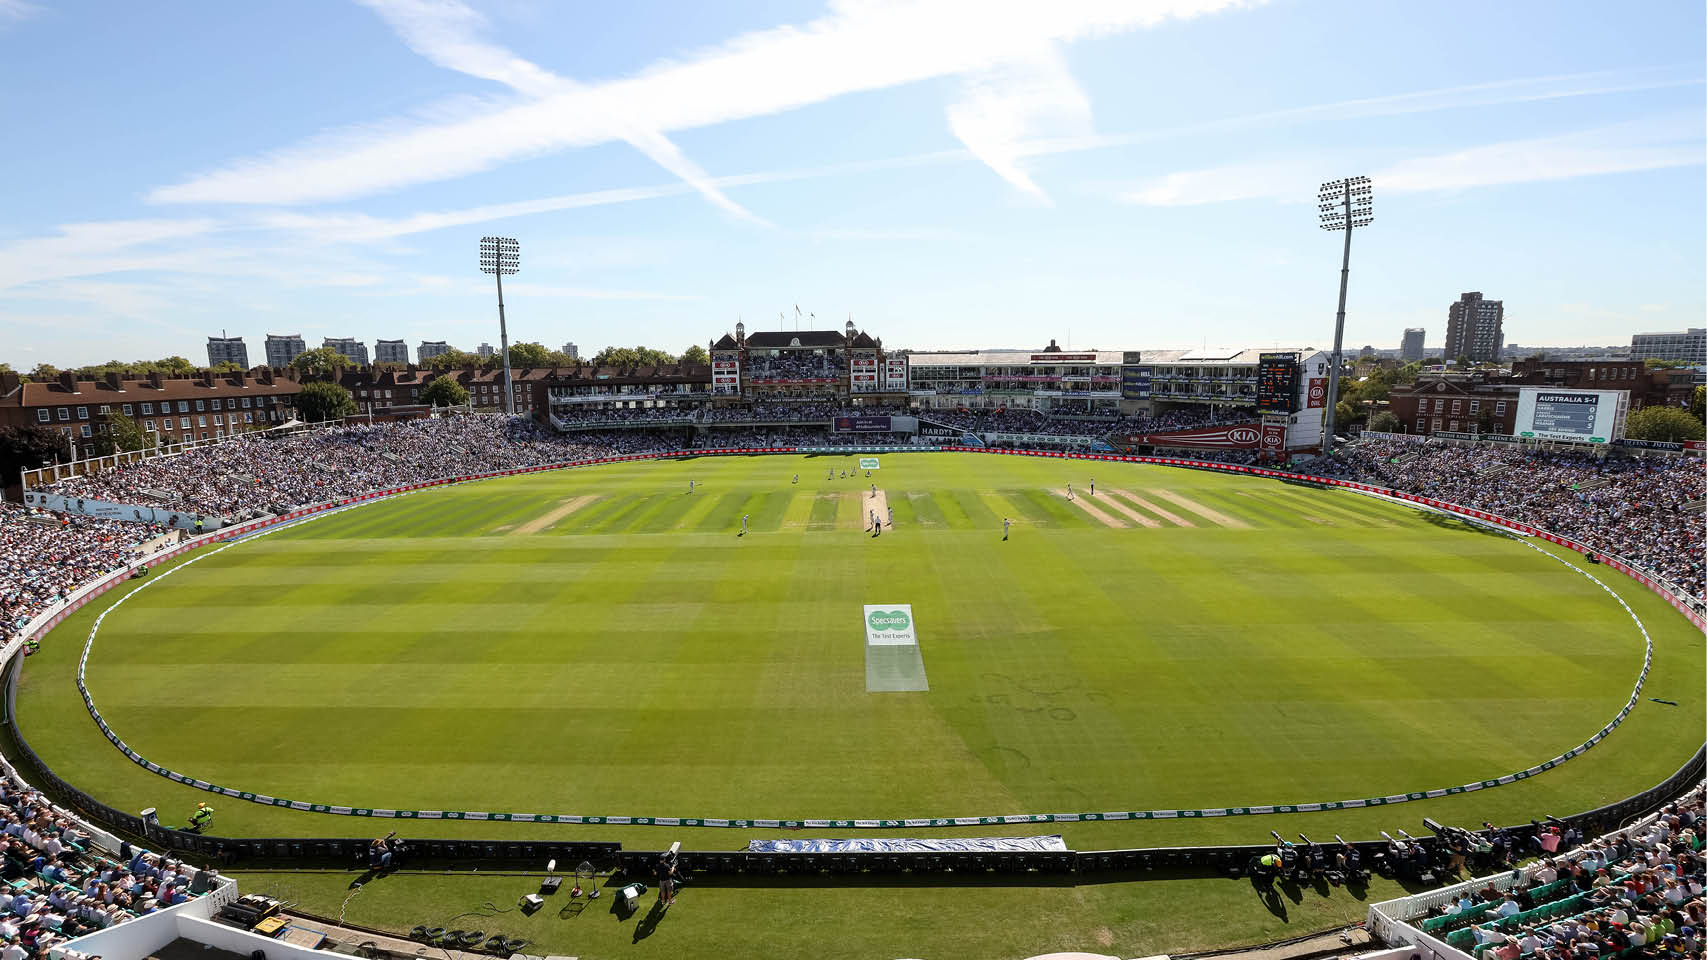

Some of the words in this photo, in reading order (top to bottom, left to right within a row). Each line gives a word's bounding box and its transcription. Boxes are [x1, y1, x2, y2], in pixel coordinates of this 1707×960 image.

[1538, 395, 1582, 403] AUSTRALIA
[1233, 431, 1255, 441] KIA
[871, 616, 906, 625] Specsavers
